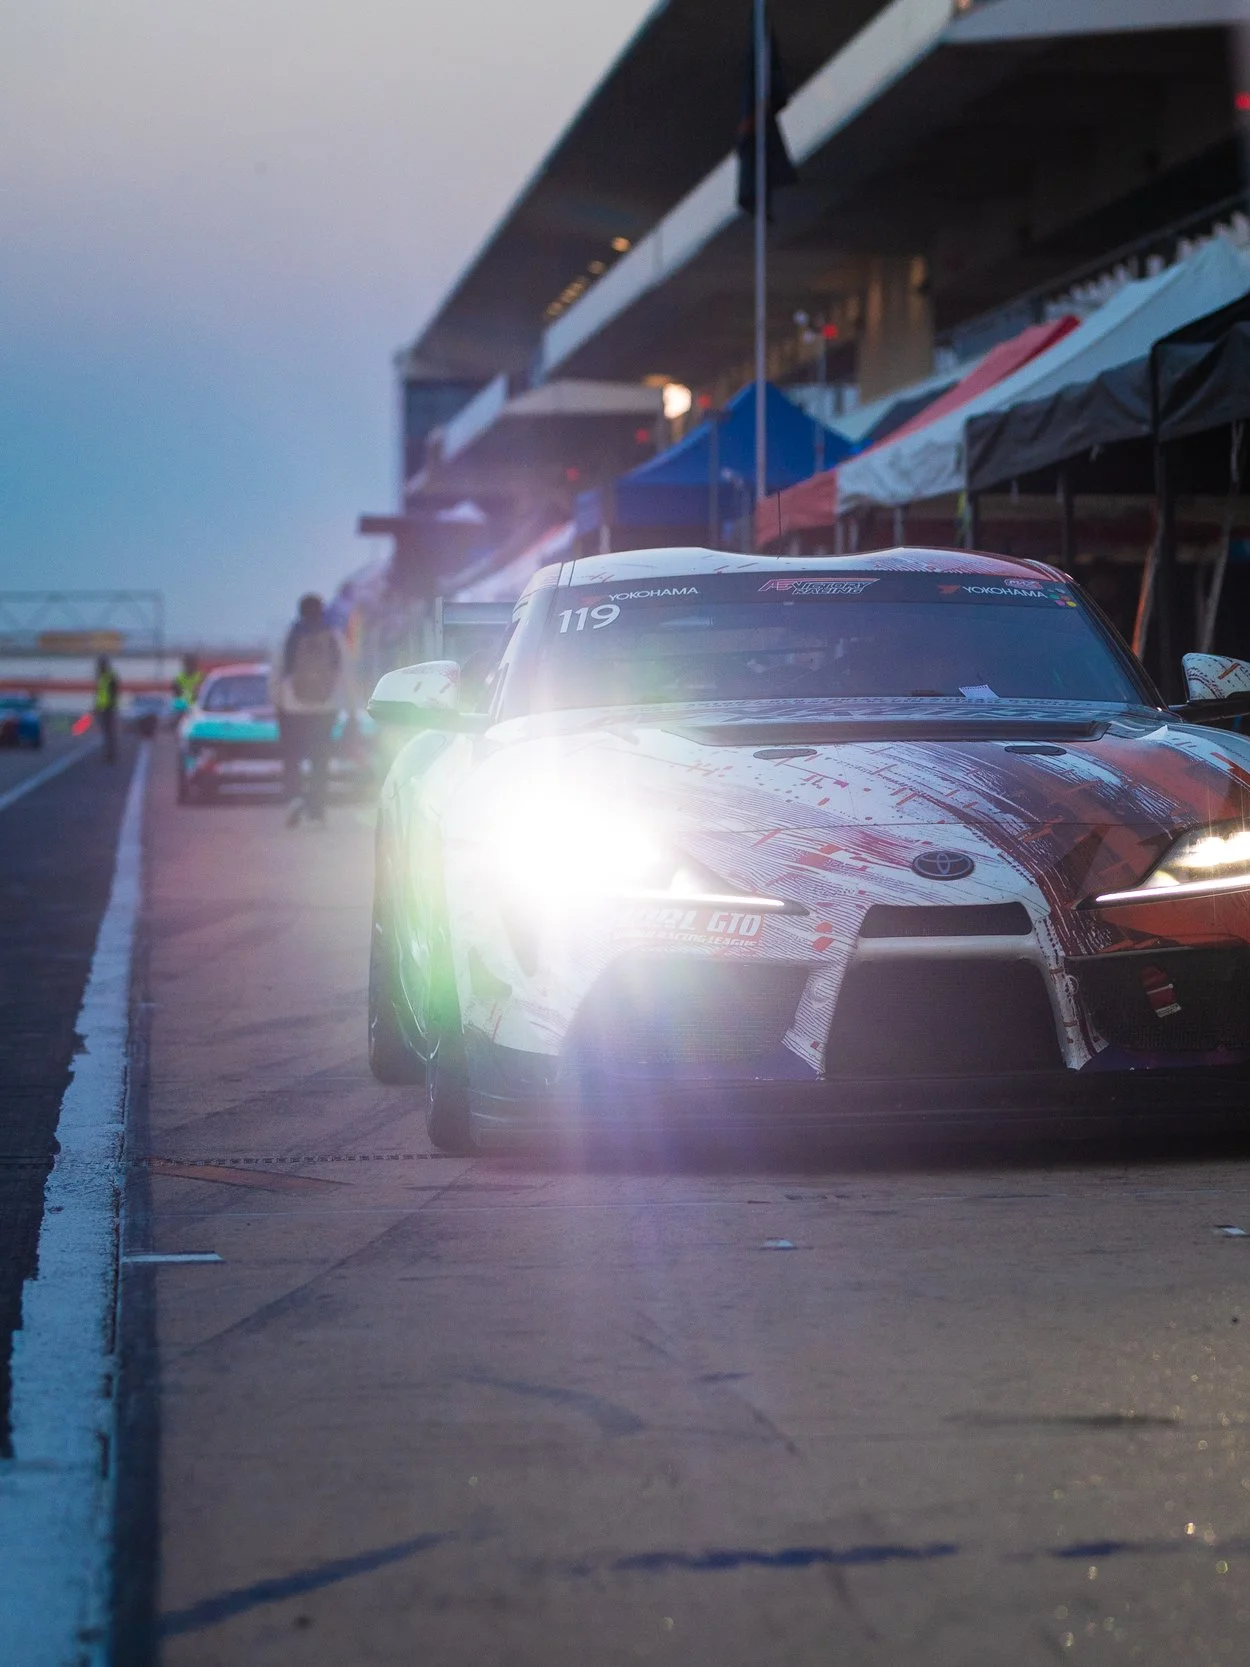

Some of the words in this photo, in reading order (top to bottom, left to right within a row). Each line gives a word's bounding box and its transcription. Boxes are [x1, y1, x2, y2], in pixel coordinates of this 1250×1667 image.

[609, 587, 699, 601] YOKOHAMA
[962, 585, 1048, 599] YOKOHAMA
[559, 603, 620, 633] 119
[706, 911, 762, 937] GTO
